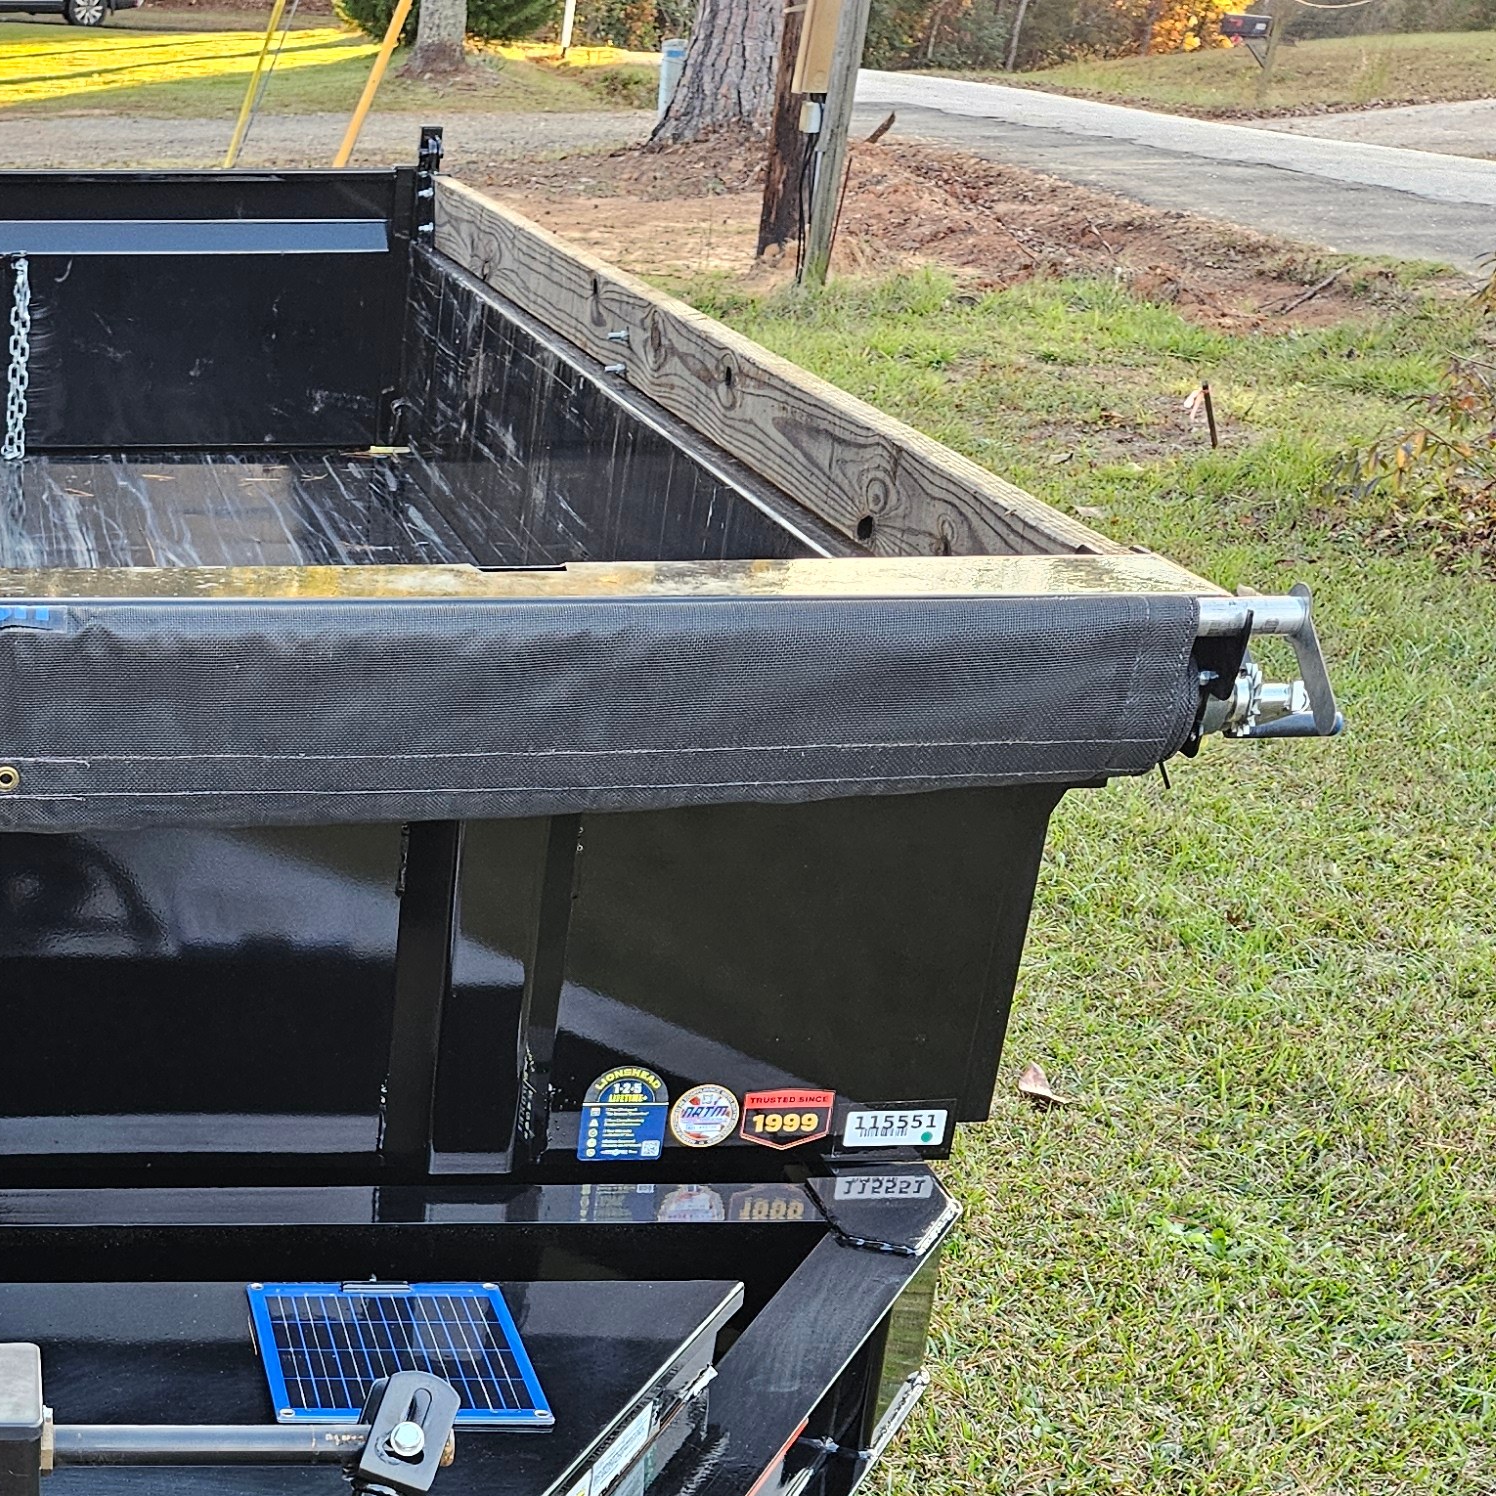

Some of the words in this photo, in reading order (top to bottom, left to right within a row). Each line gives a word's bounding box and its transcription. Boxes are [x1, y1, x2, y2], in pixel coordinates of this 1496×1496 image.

[750, 1096, 796, 1105] TRUSTED
[799, 1095, 829, 1104] SINCE
[752, 1113, 819, 1132] 1999
[854, 1114, 937, 1130] 115551
